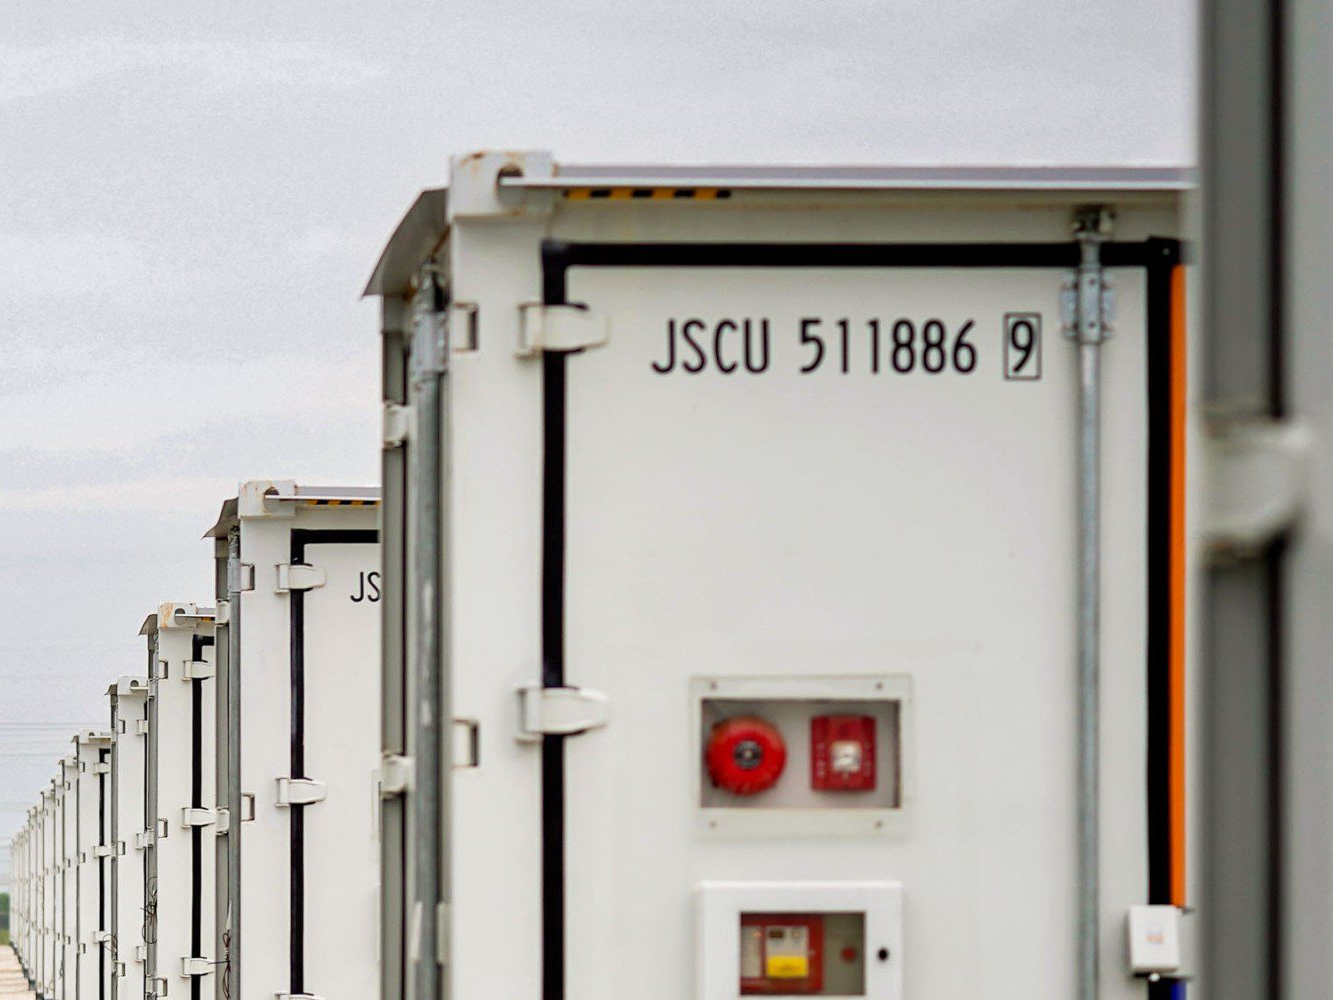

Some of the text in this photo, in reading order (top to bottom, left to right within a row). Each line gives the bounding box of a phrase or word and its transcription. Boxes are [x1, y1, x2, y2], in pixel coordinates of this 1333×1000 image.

[651, 318, 1036, 374] JSCU 511886 9
